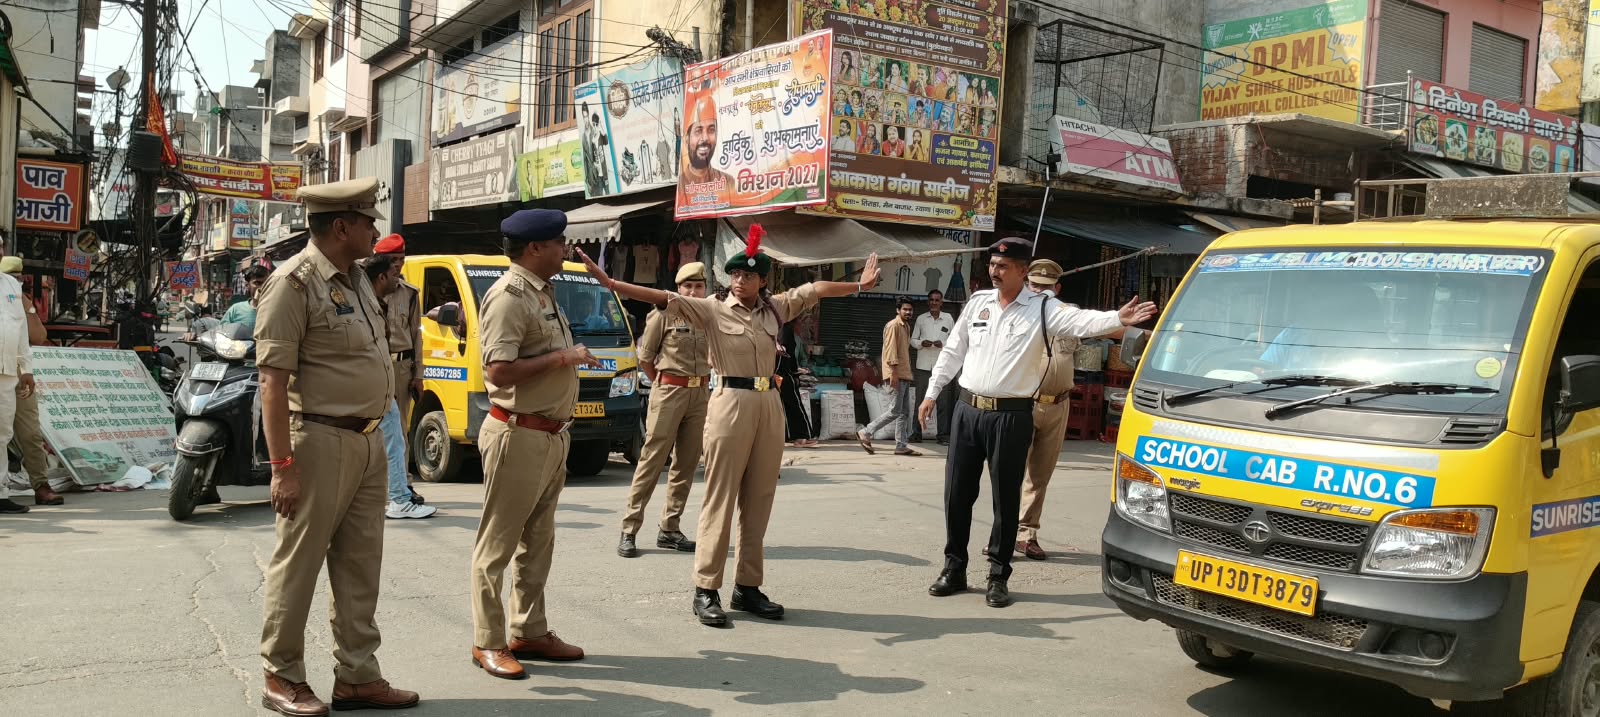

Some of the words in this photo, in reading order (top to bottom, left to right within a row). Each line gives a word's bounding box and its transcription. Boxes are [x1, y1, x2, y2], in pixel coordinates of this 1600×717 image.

[1332, 32, 1357, 48] OPEN
[1253, 34, 1327, 76] DPMI
[737, 69, 749, 82] सभी
[782, 73, 827, 116] दीपावली
[1202, 99, 1272, 121] PARAMEDICAL
[1275, 91, 1320, 111] COLLEGE
[1203, 86, 1240, 104] VIJAY
[1245, 79, 1285, 98] SHREE
[1060, 119, 1097, 133] HITACHI
[1428, 85, 1478, 121] दिनेश
[1533, 118, 1566, 142] वाले
[450, 144, 476, 163] CHERRY
[475, 139, 495, 158] TYAGI
[719, 130, 754, 166] हार्दिक
[22, 165, 67, 190] पाव
[737, 168, 785, 193] मिशन
[787, 164, 819, 187] 2027
[1125, 150, 1175, 179] ATM
[831, 171, 886, 193] आकाश
[887, 172, 921, 197] गंगा
[923, 176, 970, 203] साड़ीज
[467, 269, 503, 278] SUNRISE
[564, 274, 589, 284] SIYANA
[1142, 438, 1229, 474] SCHOOL
[1245, 454, 1298, 485] CAB
[1313, 464, 1419, 504] R.NO.6
[1169, 476, 1202, 489] magic
[1300, 498, 1375, 516] express
[1532, 501, 1600, 532] SUNRISE
[1190, 559, 1313, 607] UP13DT3879
